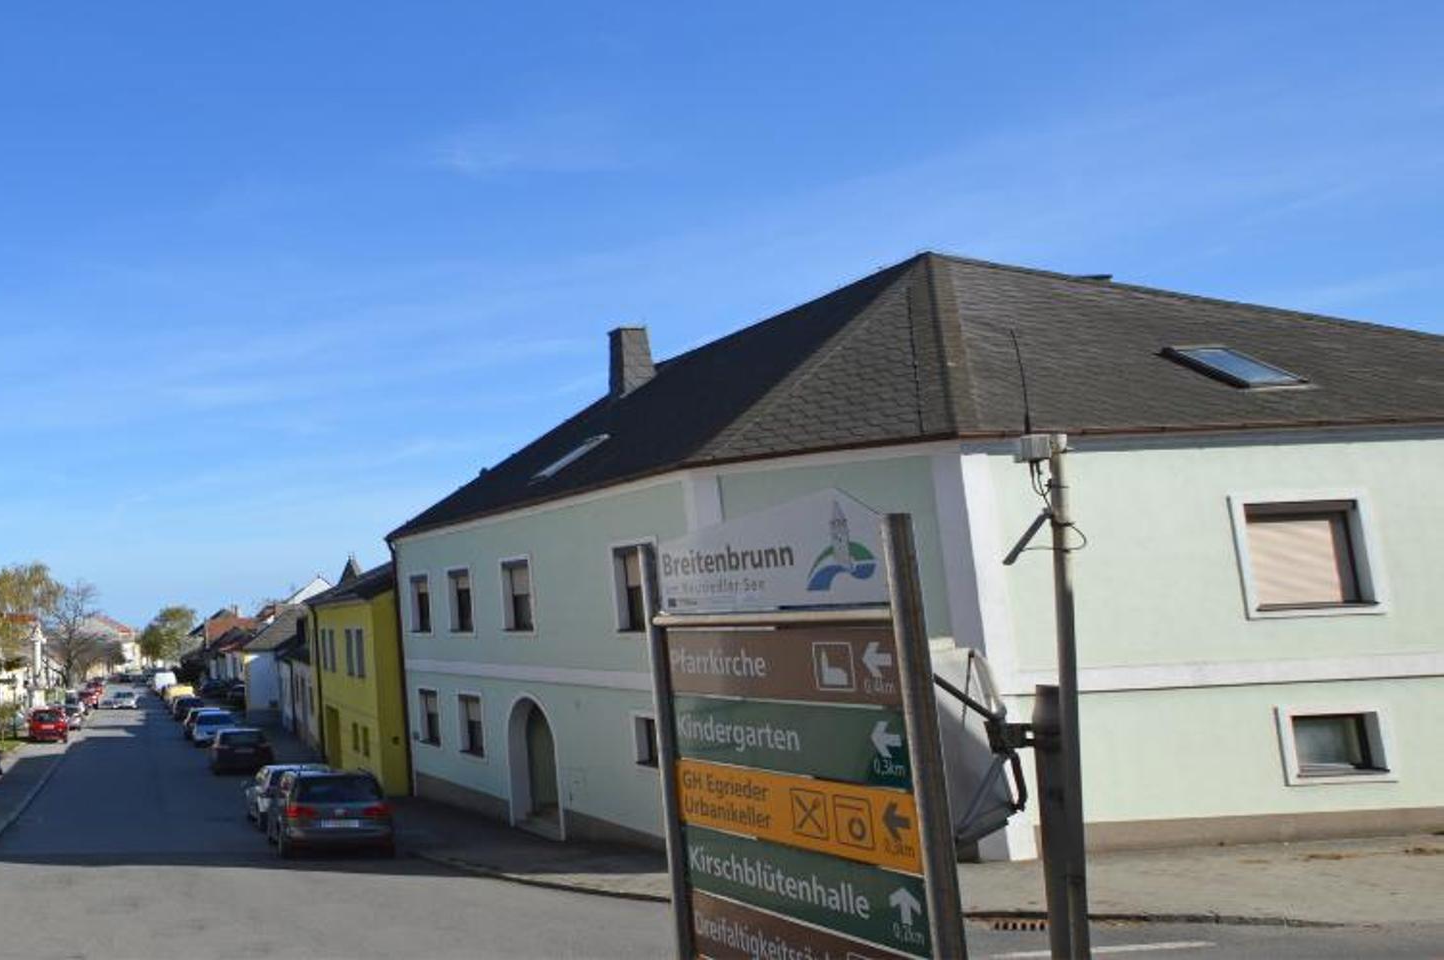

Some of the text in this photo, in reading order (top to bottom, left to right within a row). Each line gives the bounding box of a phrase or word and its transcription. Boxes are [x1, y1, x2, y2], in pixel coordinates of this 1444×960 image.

[662, 543, 795, 576] Breitenbrunn
[670, 647, 767, 677] Pfarrkirche
[677, 712, 801, 753] Kindergarten
[683, 770, 703, 789] GH
[688, 844, 871, 920] Kirschblütenhalle
